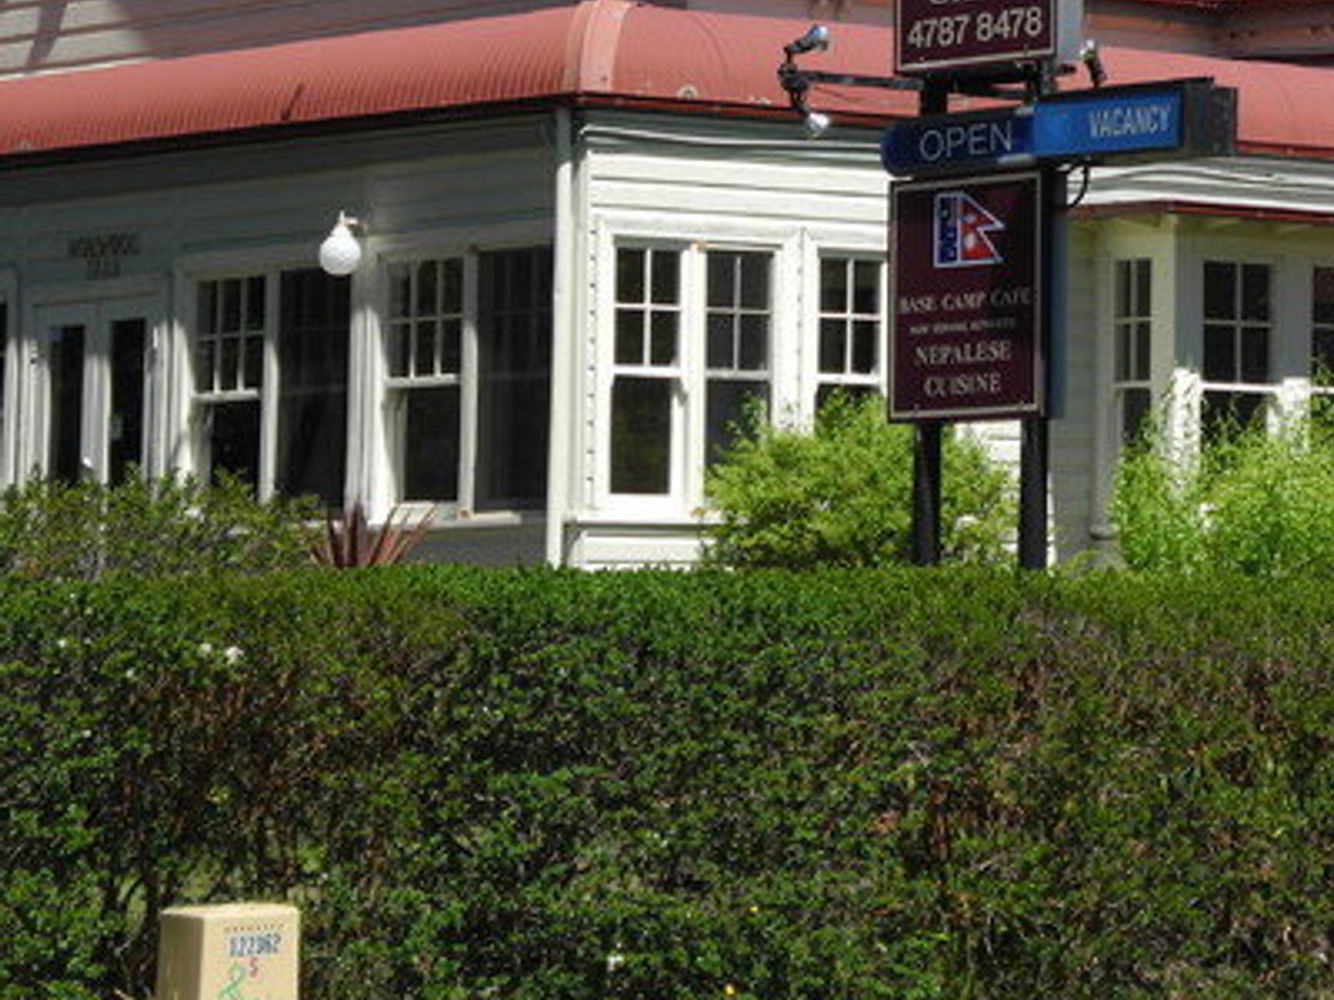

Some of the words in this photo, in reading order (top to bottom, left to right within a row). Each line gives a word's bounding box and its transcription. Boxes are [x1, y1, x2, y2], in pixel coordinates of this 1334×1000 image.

[907, 16, 969, 49] 4787
[976, 6, 1043, 41] 8478
[1087, 104, 1173, 138] VACANCY
[918, 121, 1014, 162] OPEN
[914, 339, 1013, 368] NEPALESE
[923, 372, 1002, 399] CUISINE
